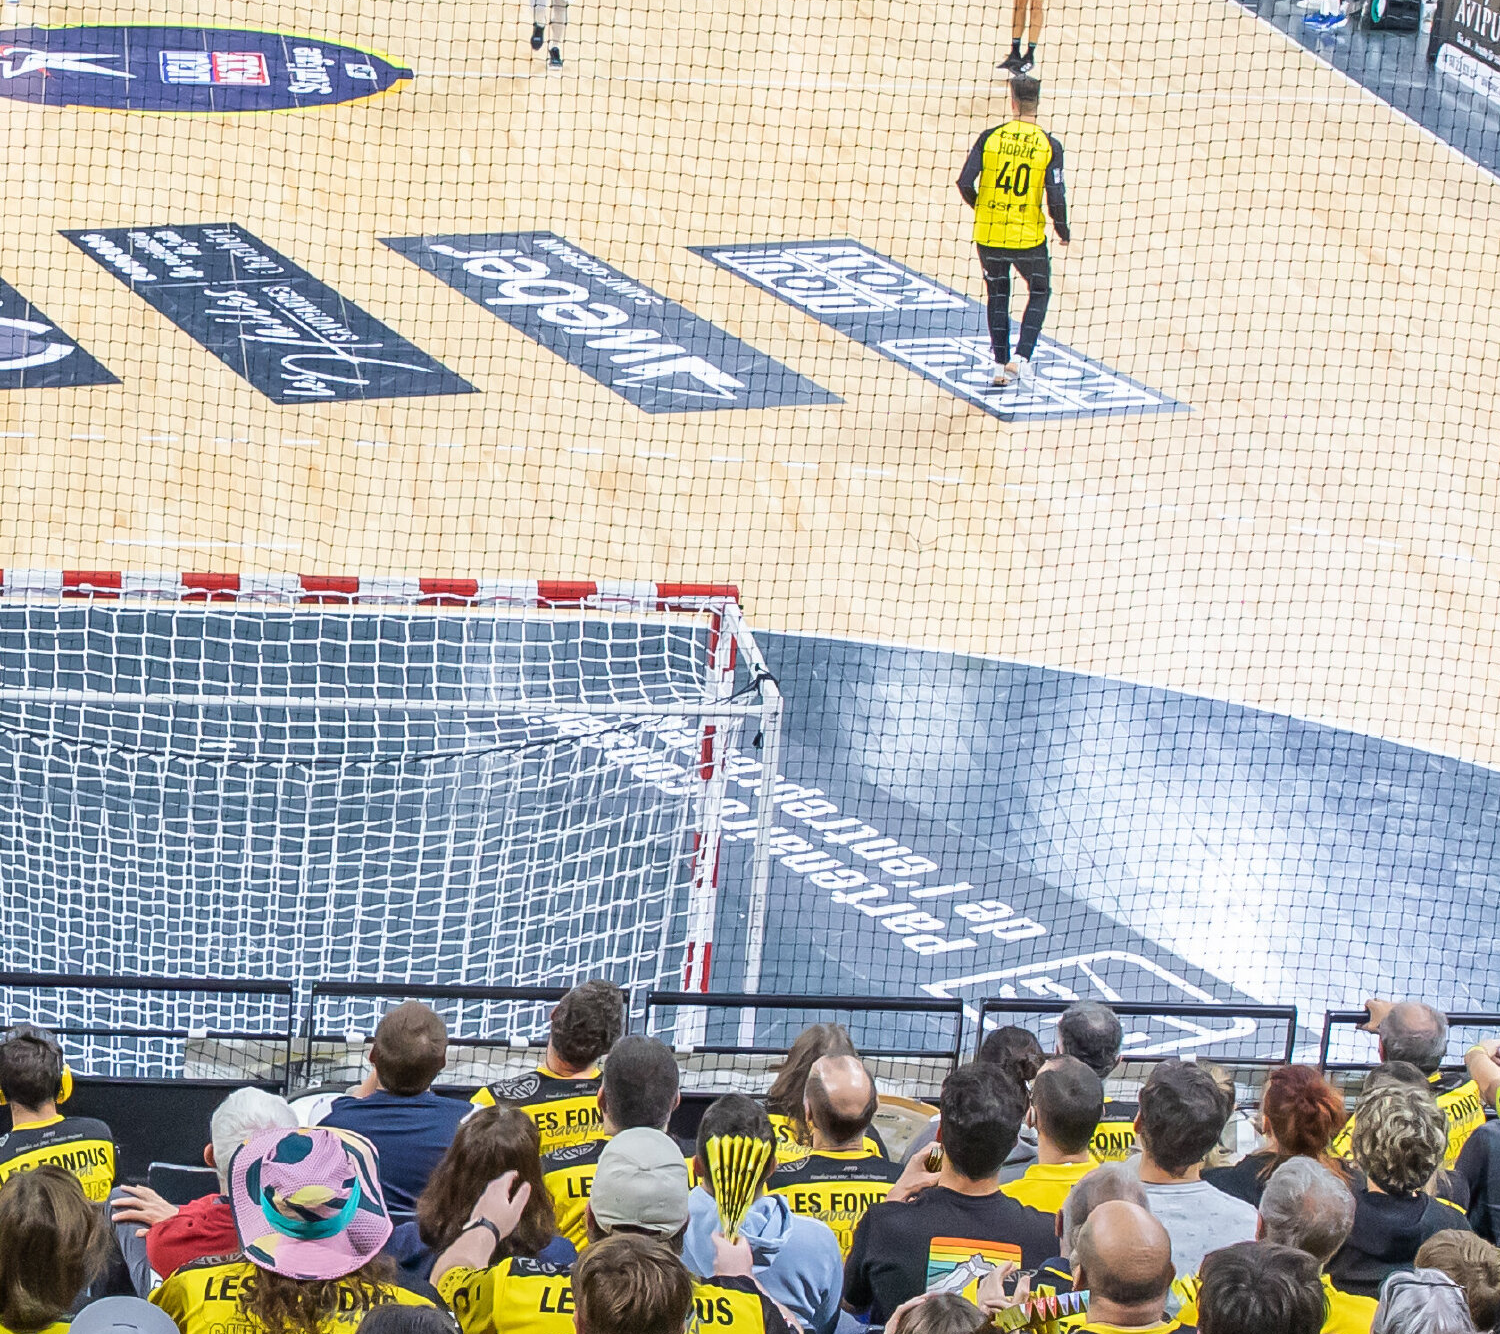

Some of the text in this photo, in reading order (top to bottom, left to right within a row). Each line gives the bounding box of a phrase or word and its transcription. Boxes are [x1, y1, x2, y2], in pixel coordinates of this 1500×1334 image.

[995, 161, 1031, 197] 40
[712, 252, 891, 314] LIQUI
[786, 246, 968, 310] MOLY
[257, 285, 364, 341] SAVOYARDES
[430, 243, 687, 365] weber
[205, 287, 434, 385] Halles
[953, 898, 1048, 942] de
[533, 1108, 603, 1132] ES FON
[1090, 1130, 1136, 1149] FOND
[566, 1176, 592, 1198] LE
[788, 1192, 888, 1214] LES FOND
[203, 1275, 254, 1302] LES
[539, 1286, 575, 1314] LE
